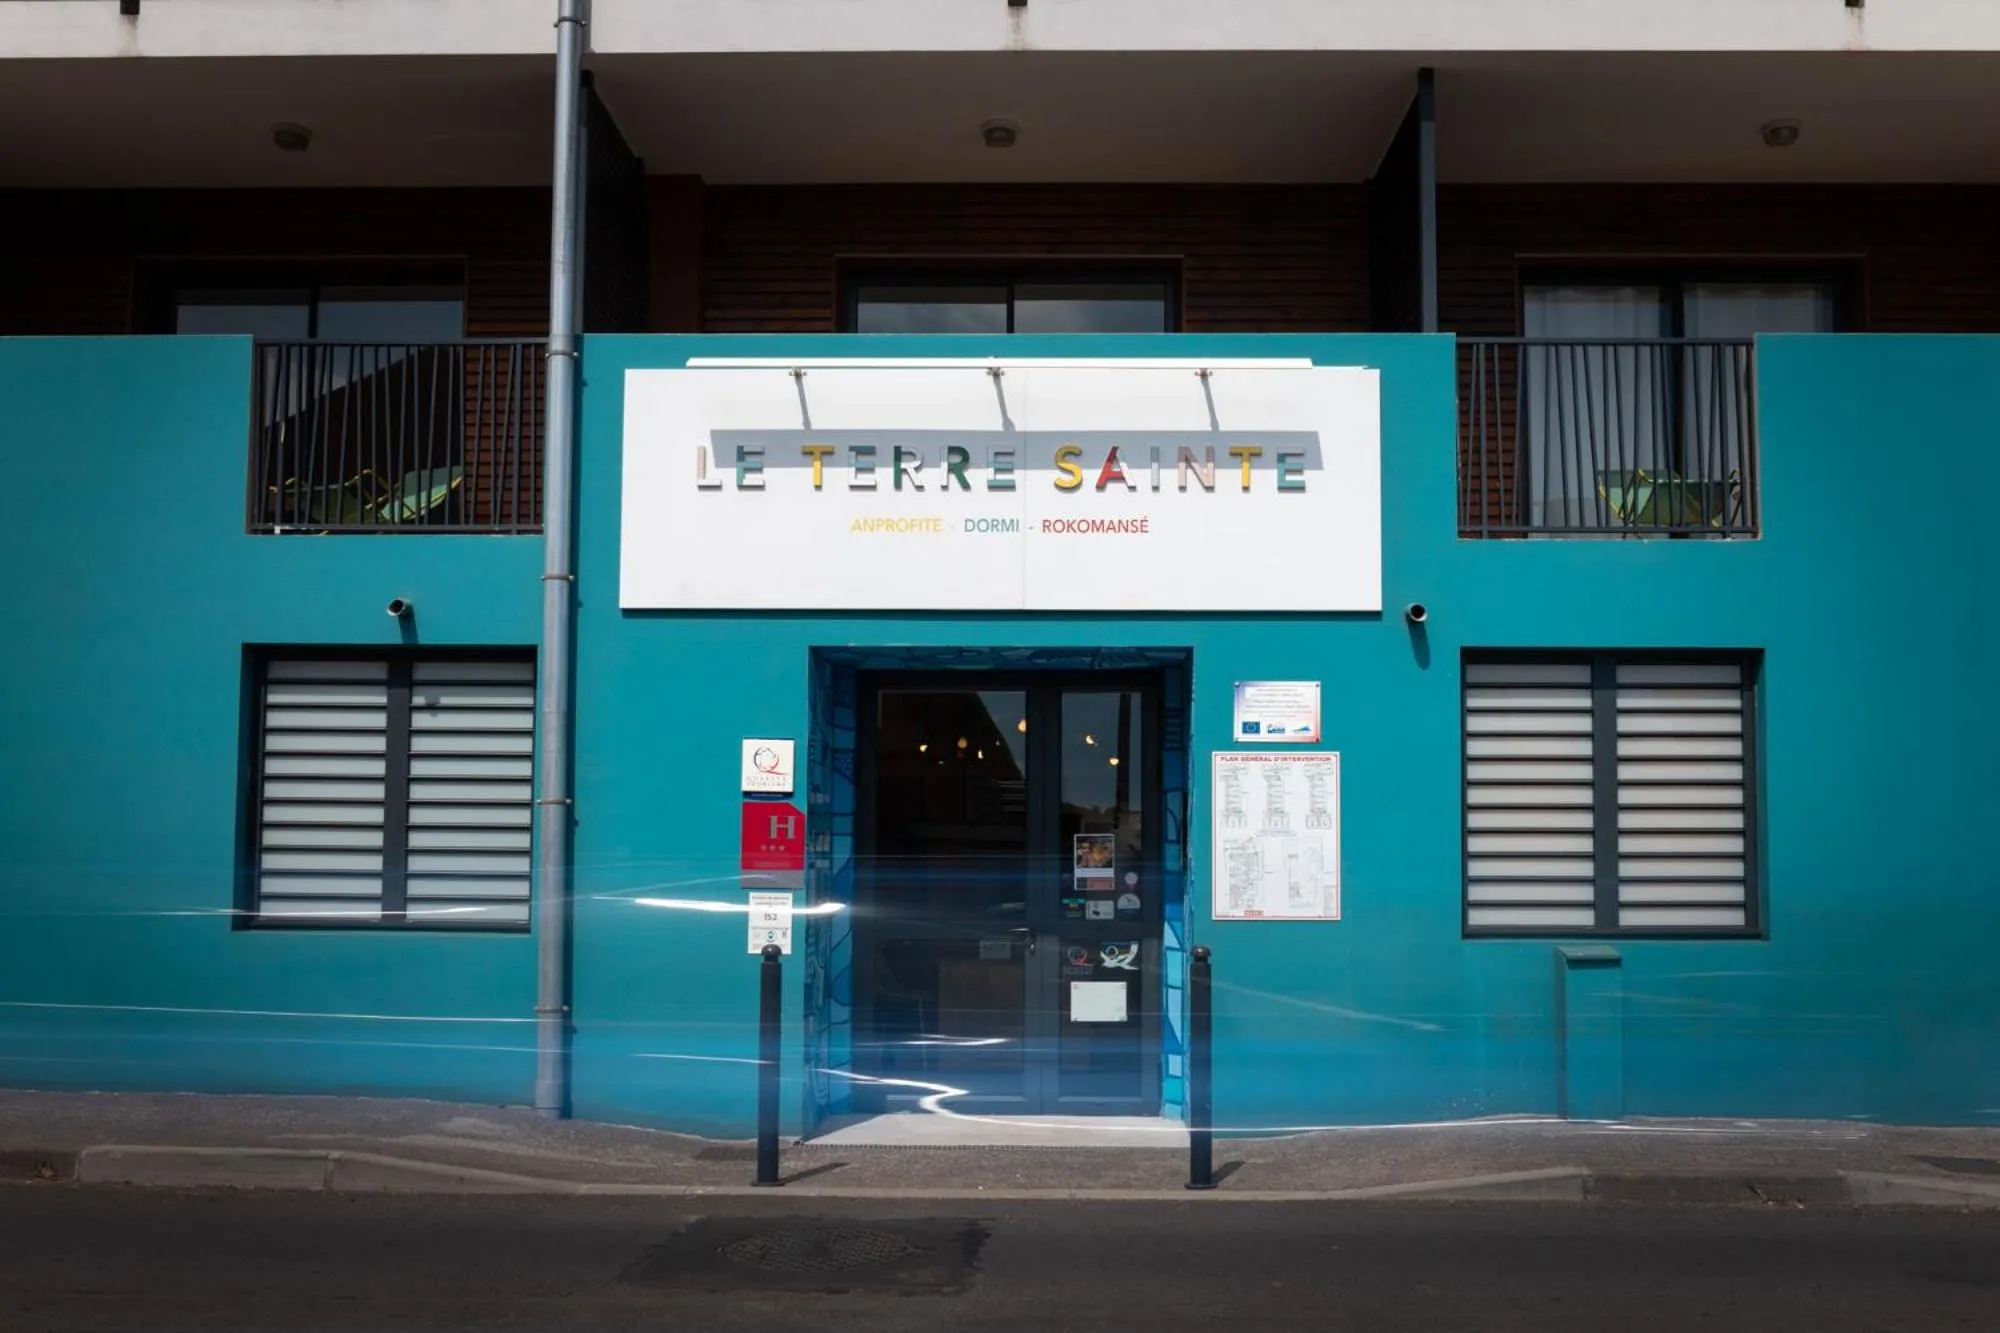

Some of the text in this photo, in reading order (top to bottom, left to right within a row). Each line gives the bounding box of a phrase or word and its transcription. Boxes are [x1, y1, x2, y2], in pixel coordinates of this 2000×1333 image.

[697, 445, 1306, 492] LE TERRE SAINTE
[965, 519, 1020, 533] DORMI
[1042, 517, 1149, 534] ROKOMANSÉ
[768, 815, 797, 840] H
